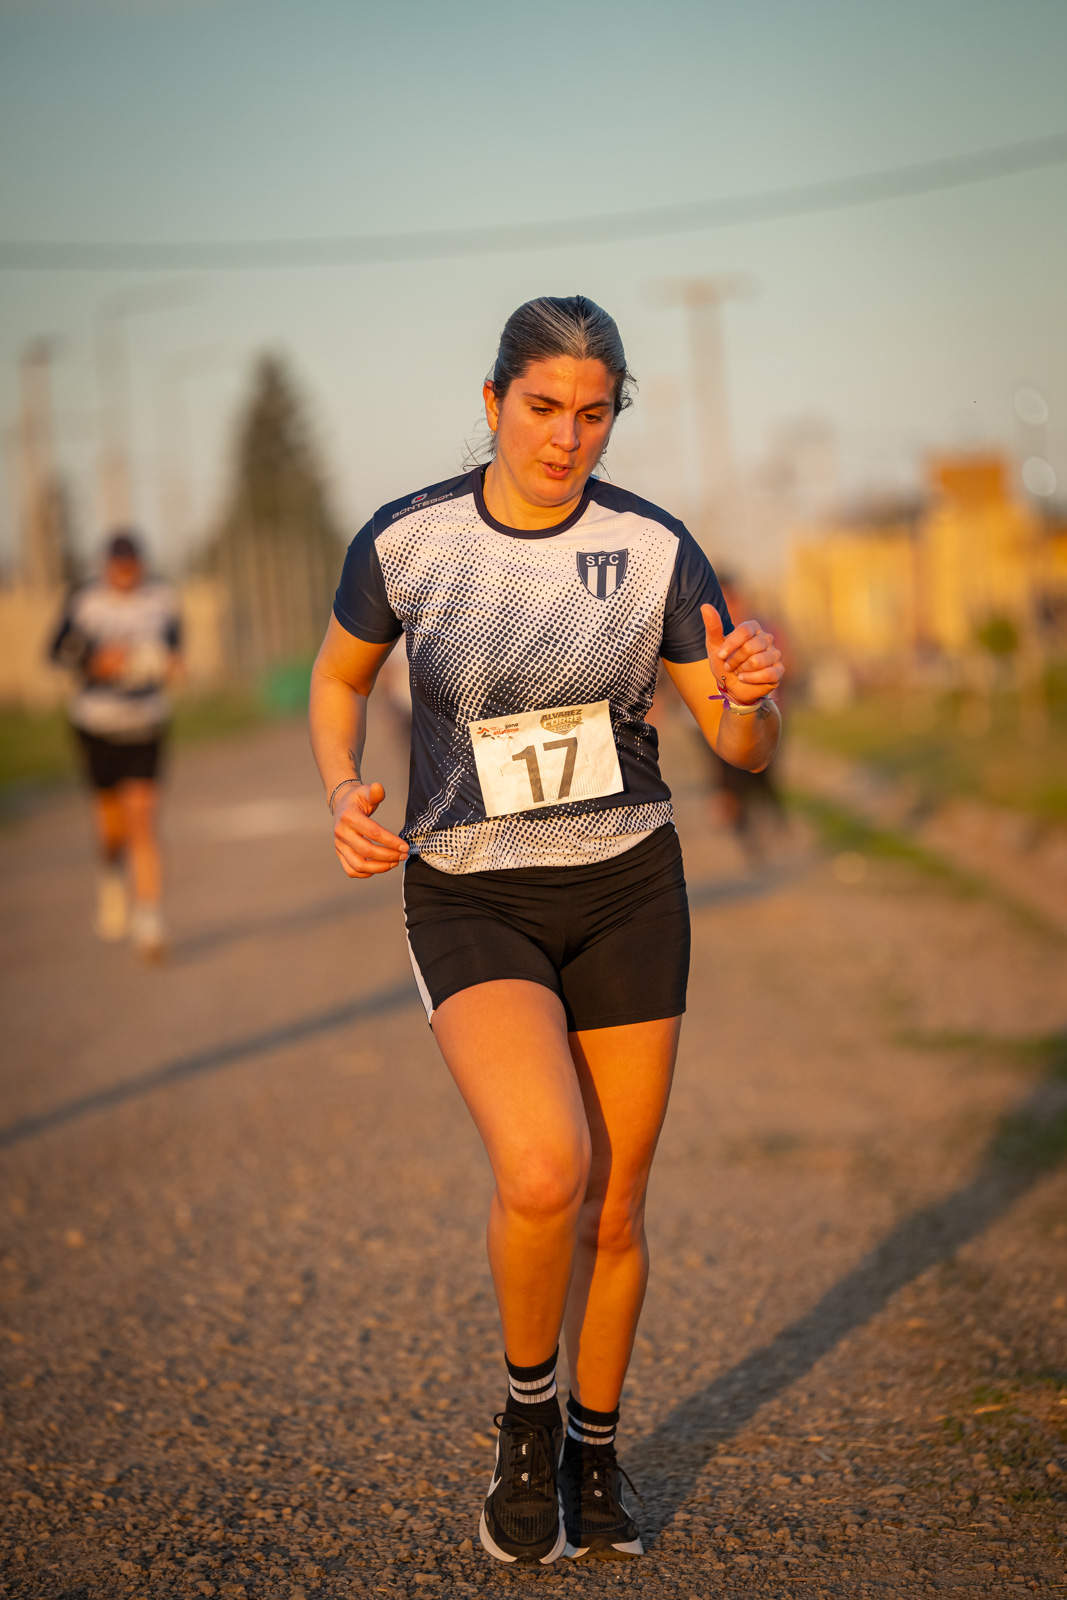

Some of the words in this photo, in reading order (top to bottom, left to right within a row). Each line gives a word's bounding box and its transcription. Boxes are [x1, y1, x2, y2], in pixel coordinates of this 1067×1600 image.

[586, 554, 619, 566] SFC
[540, 709, 583, 722] ALVAREZ
[543, 715, 581, 727] CORRE
[512, 737, 577, 803] 17
